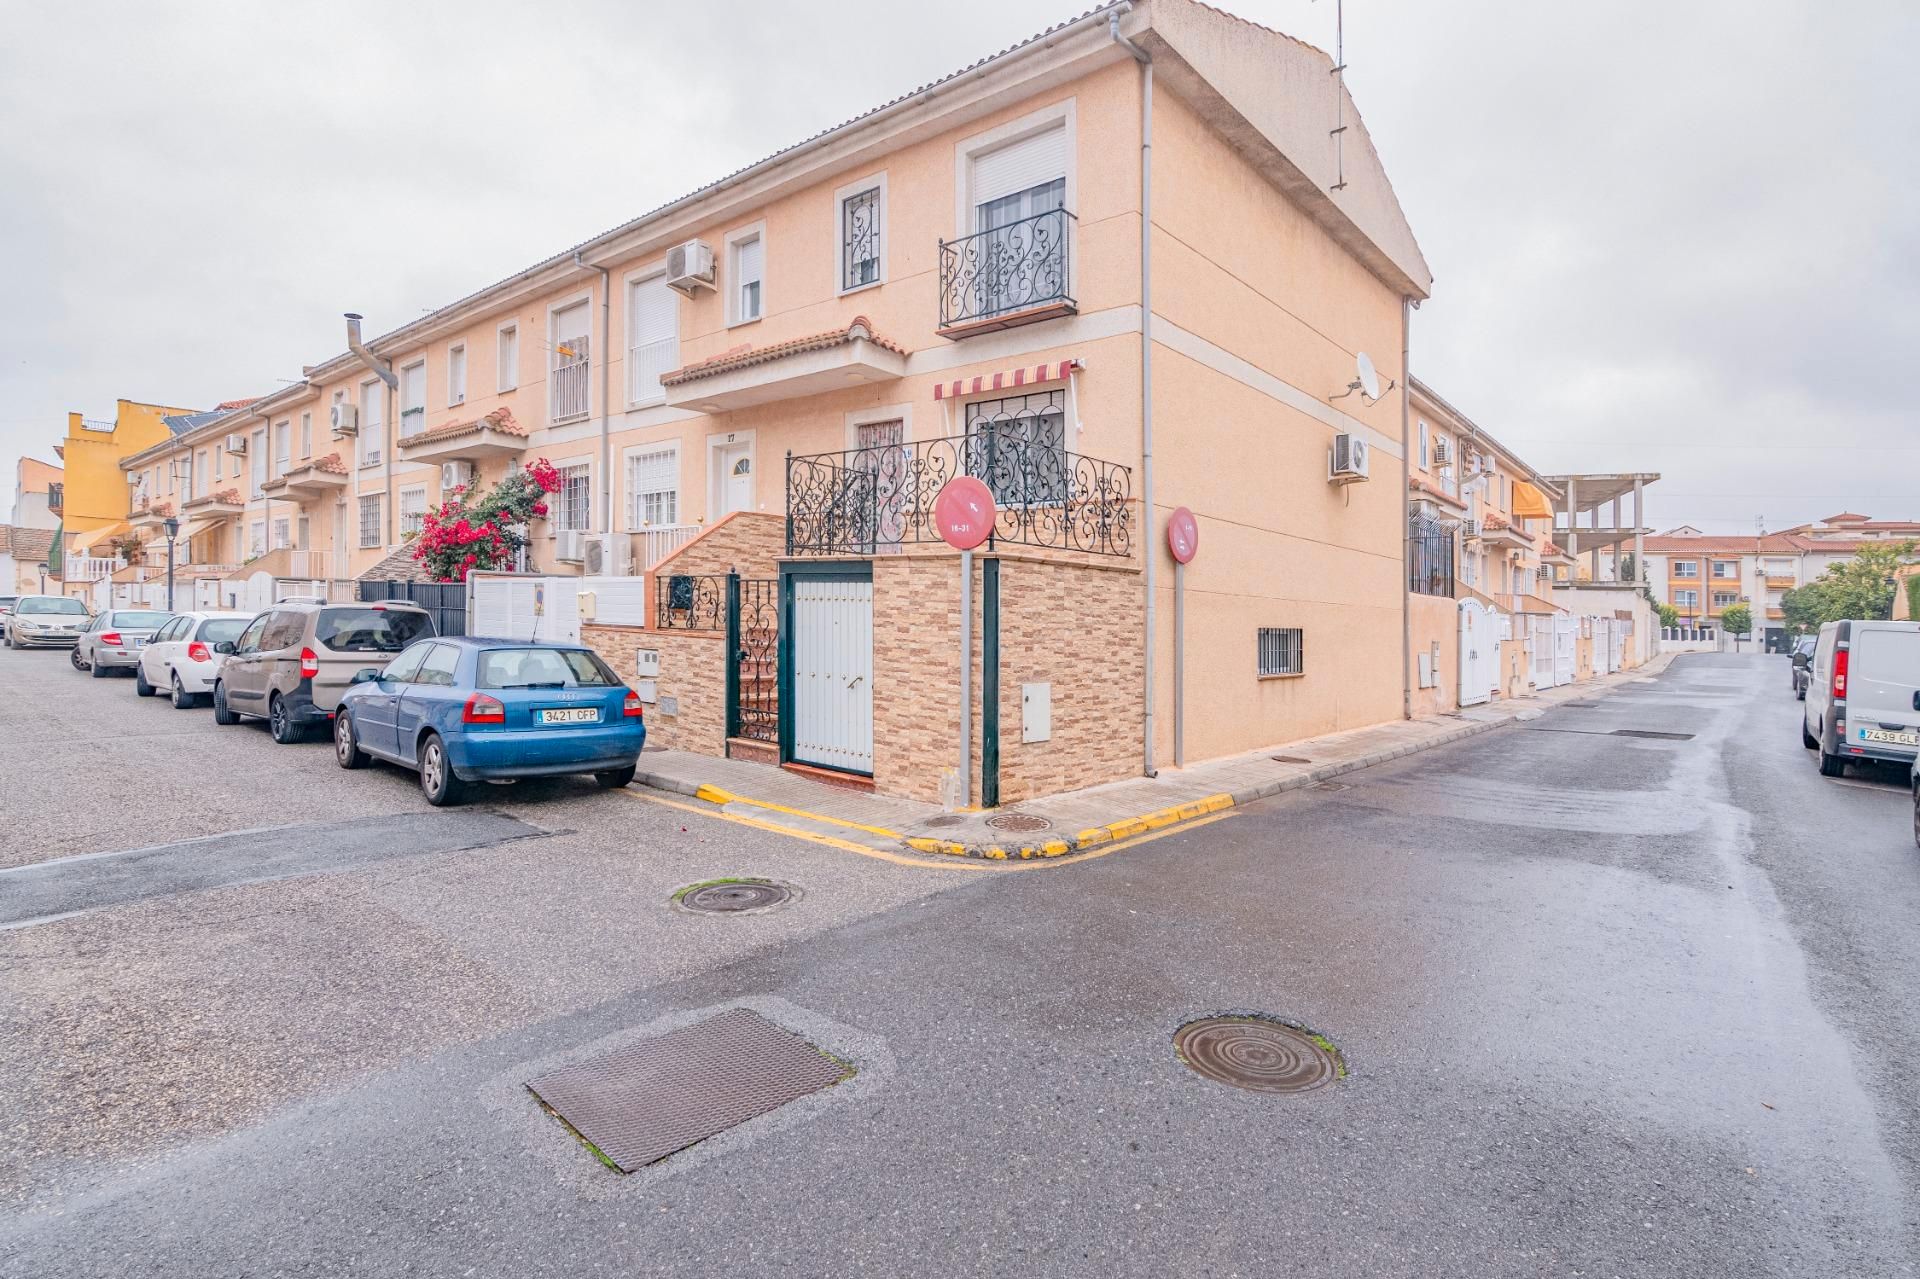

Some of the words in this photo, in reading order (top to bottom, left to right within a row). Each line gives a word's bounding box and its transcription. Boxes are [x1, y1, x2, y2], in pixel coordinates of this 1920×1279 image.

[728, 433, 735, 443] 17
[951, 524, 969, 532] 16-31
[546, 710, 571, 721] 3421
[577, 710, 596, 720] CFP
[1867, 730, 1895, 741] 7439
